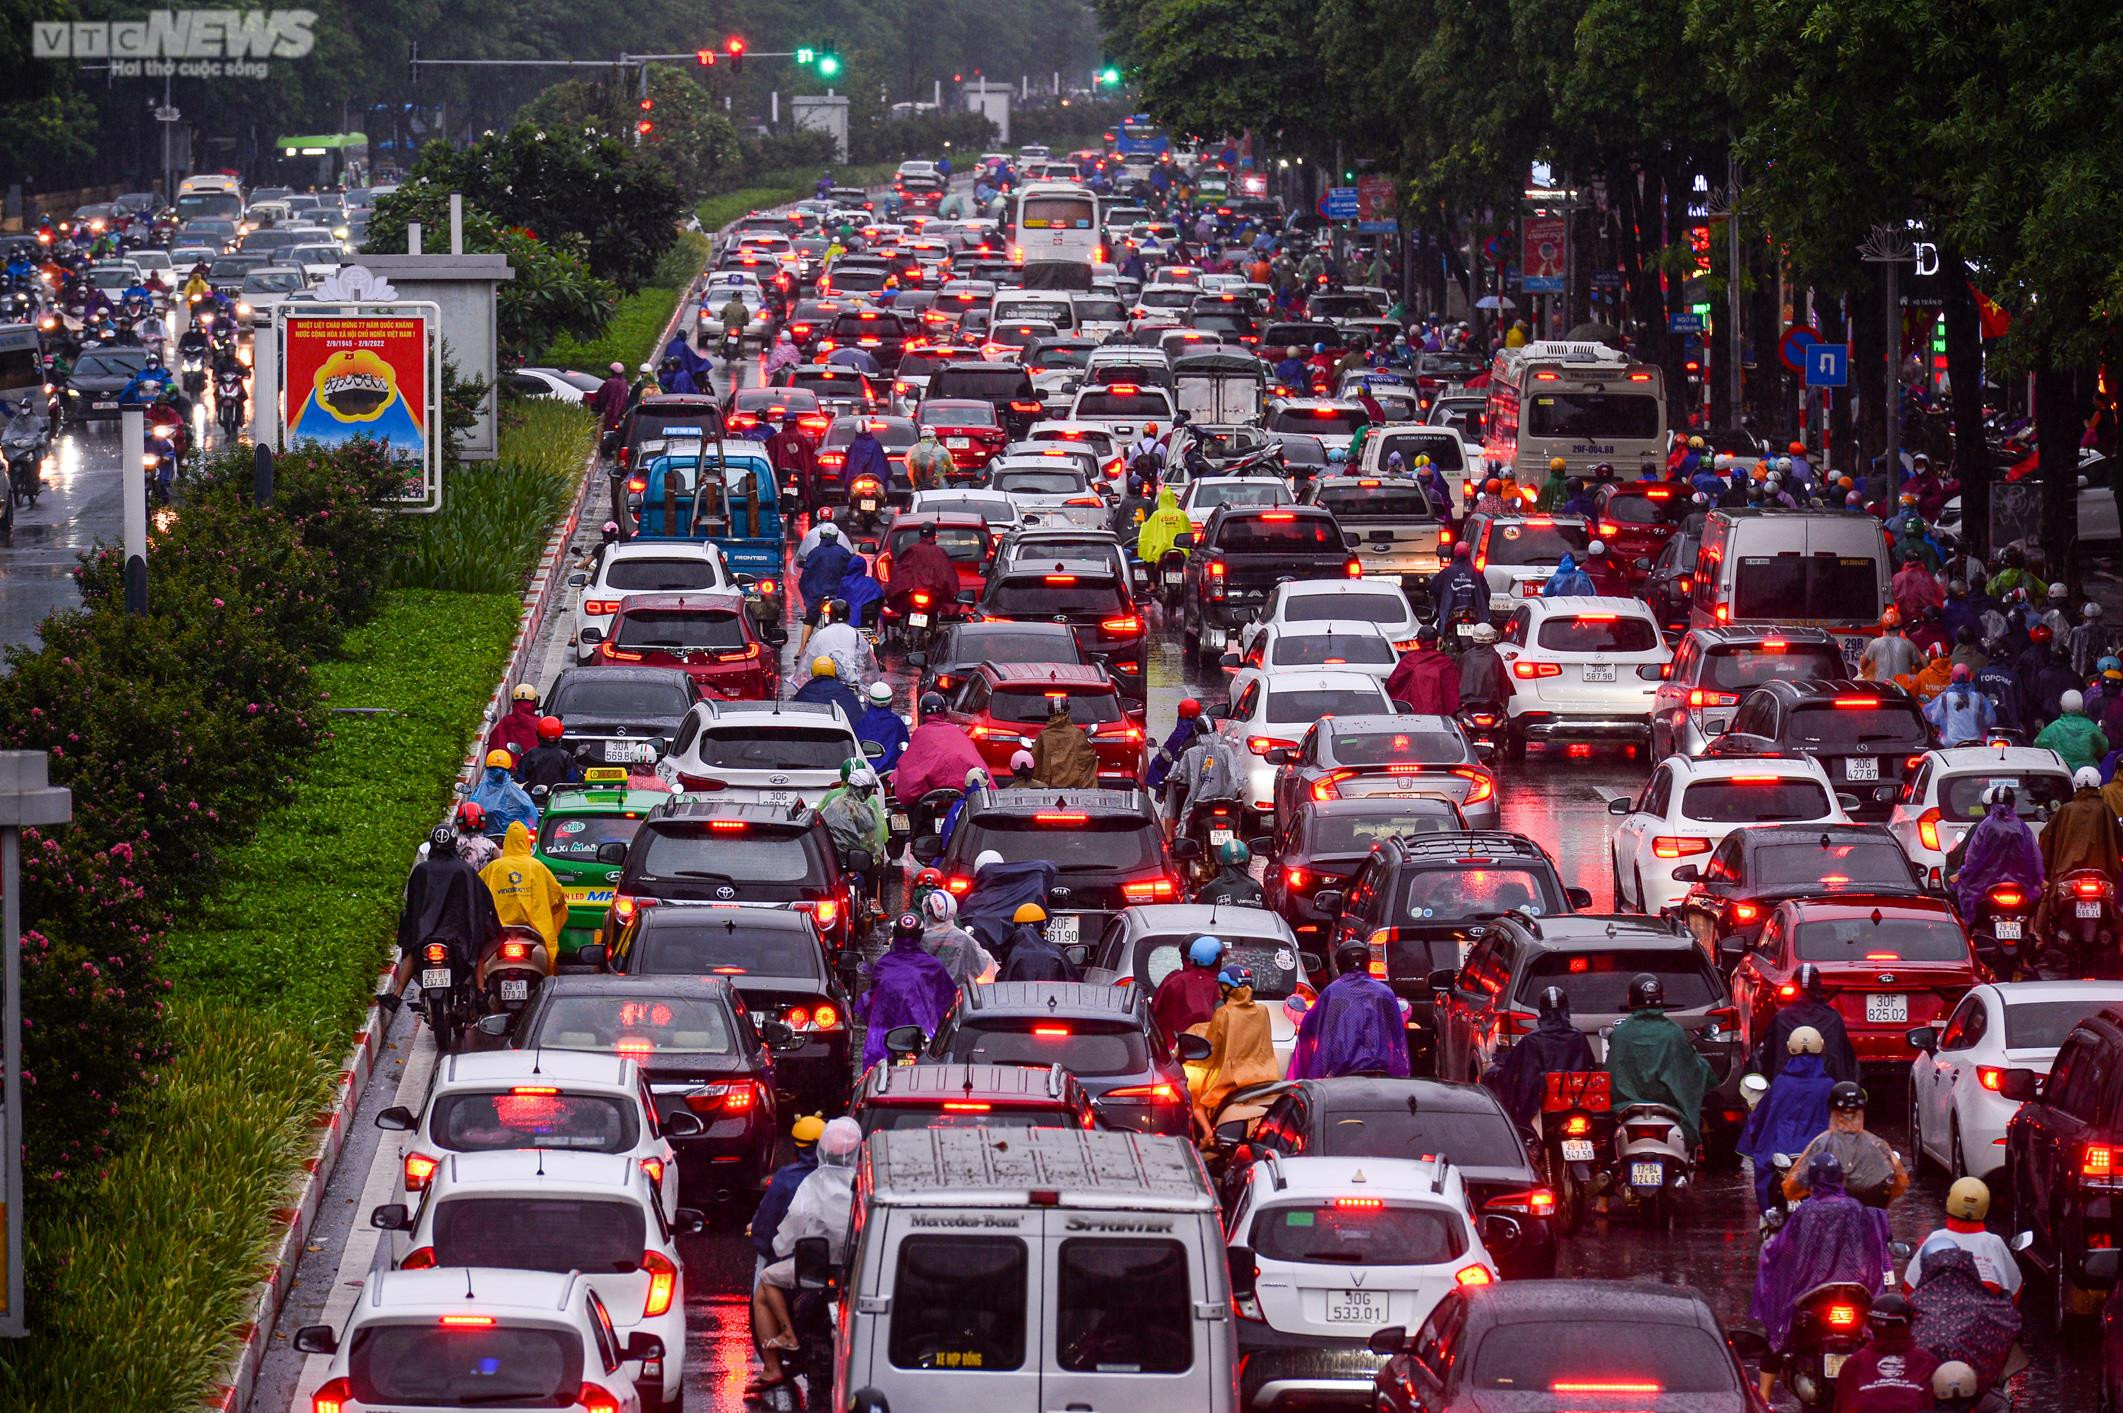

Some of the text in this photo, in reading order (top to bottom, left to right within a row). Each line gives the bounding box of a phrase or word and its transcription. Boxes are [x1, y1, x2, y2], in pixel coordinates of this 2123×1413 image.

[1592, 664, 1607, 672] 30G
[612, 741, 629, 751] 30A
[1855, 759, 1870, 769] 30G
[1848, 770, 1877, 780] 427.87
[770, 792, 787, 801] 30G
[1050, 918, 1070, 930] 30F
[1877, 995, 1896, 1007] 30F
[1868, 1008, 1906, 1021] 825.02
[1344, 1293, 1371, 1305] 30G
[1333, 1307, 1379, 1319] 533.01
[936, 1350, 982, 1368] XE HỢP ĐỒNG
